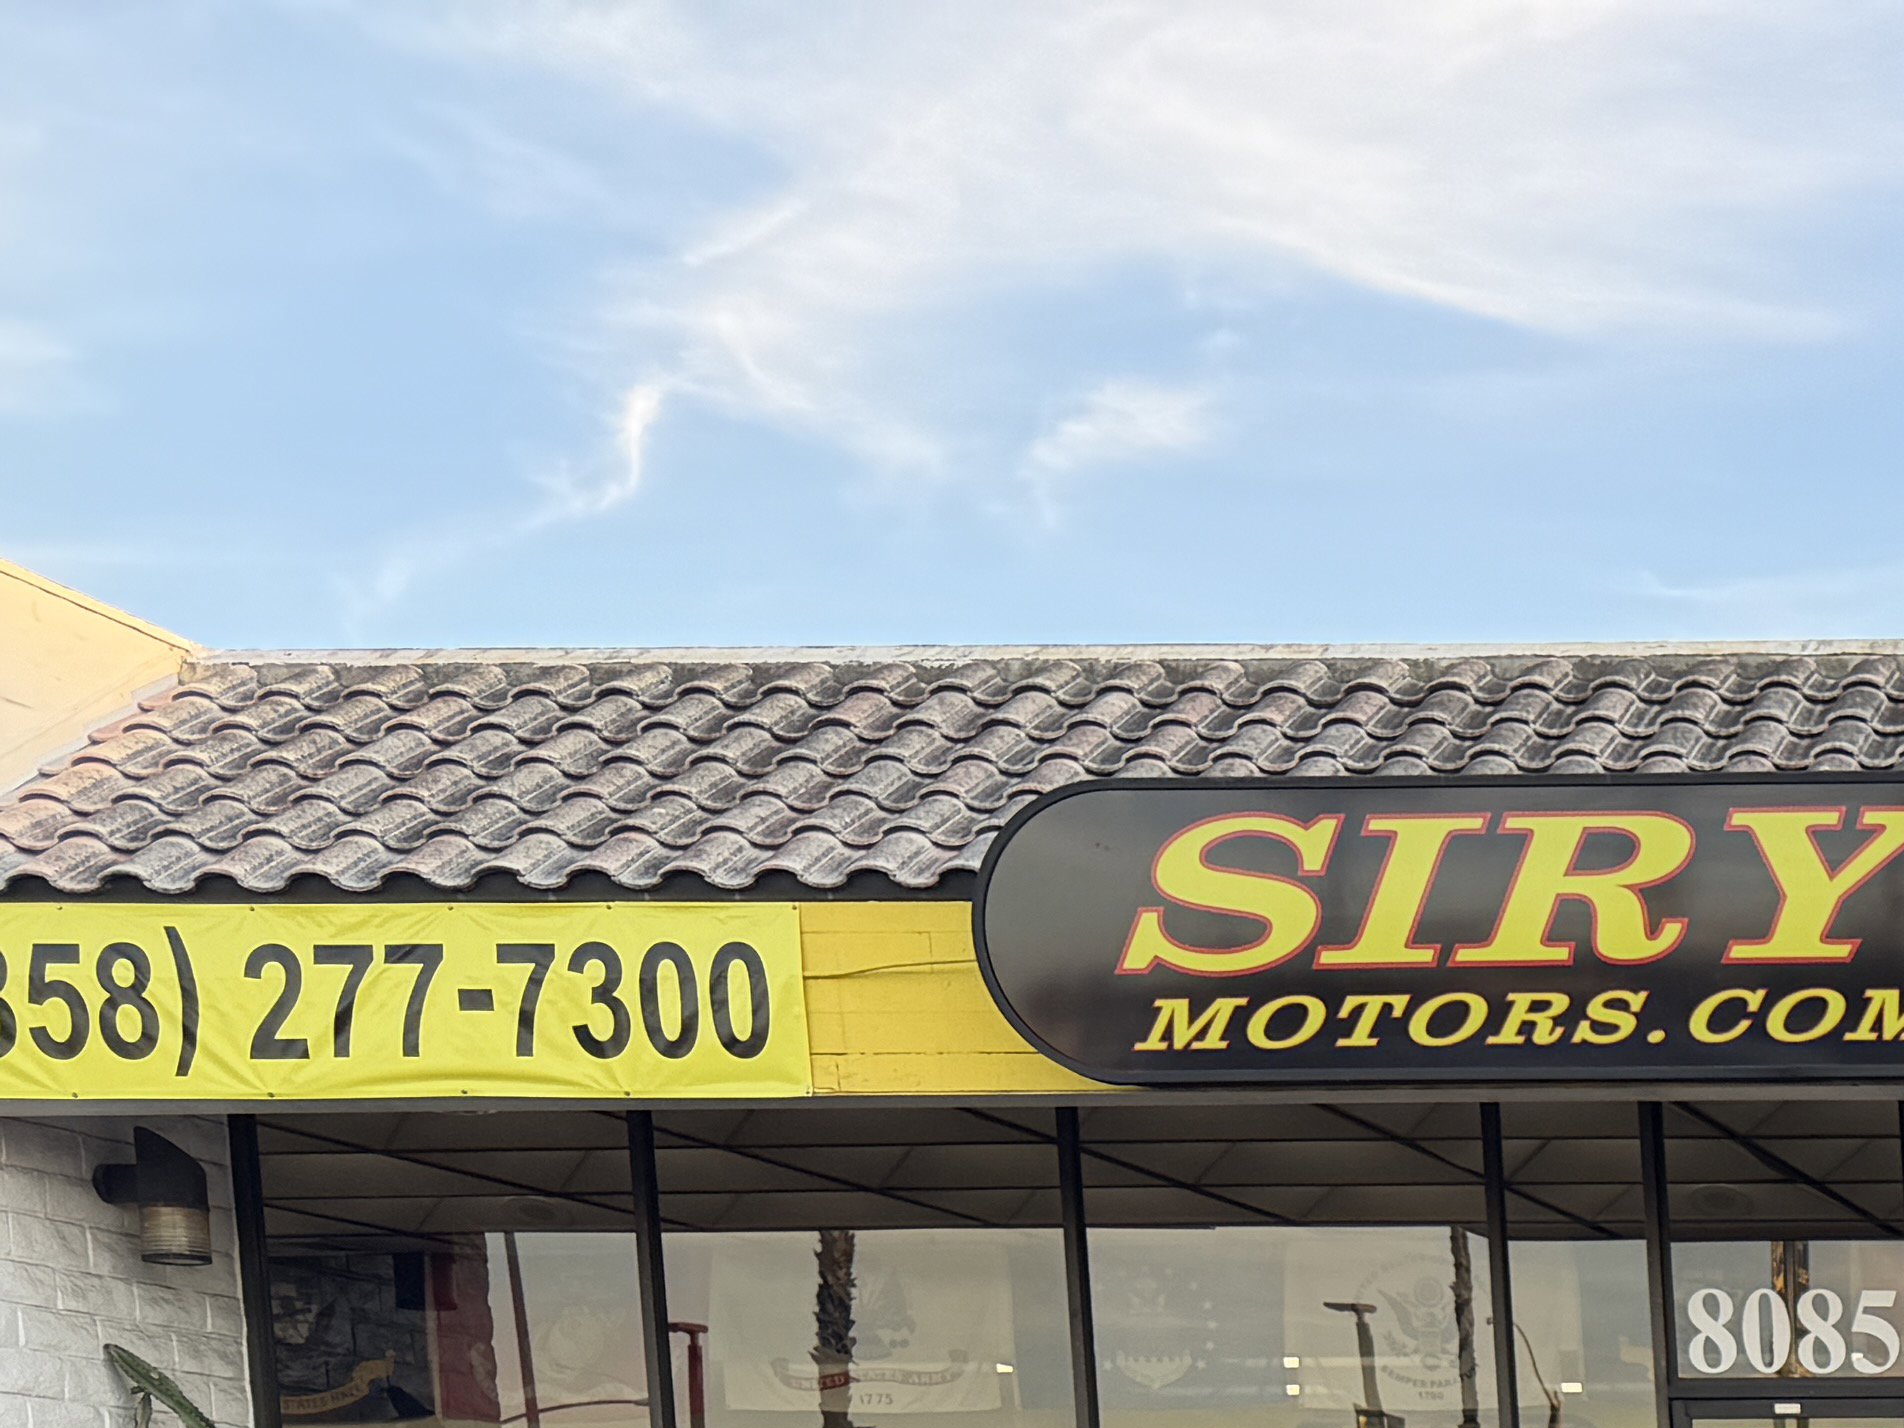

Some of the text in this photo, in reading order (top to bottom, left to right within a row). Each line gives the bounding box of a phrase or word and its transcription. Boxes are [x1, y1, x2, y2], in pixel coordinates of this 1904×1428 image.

[0, 926, 770, 1077] 58) 277-7300
[1687, 1288, 1901, 1374] 8085
[858, 1391, 894, 1406] 1775
